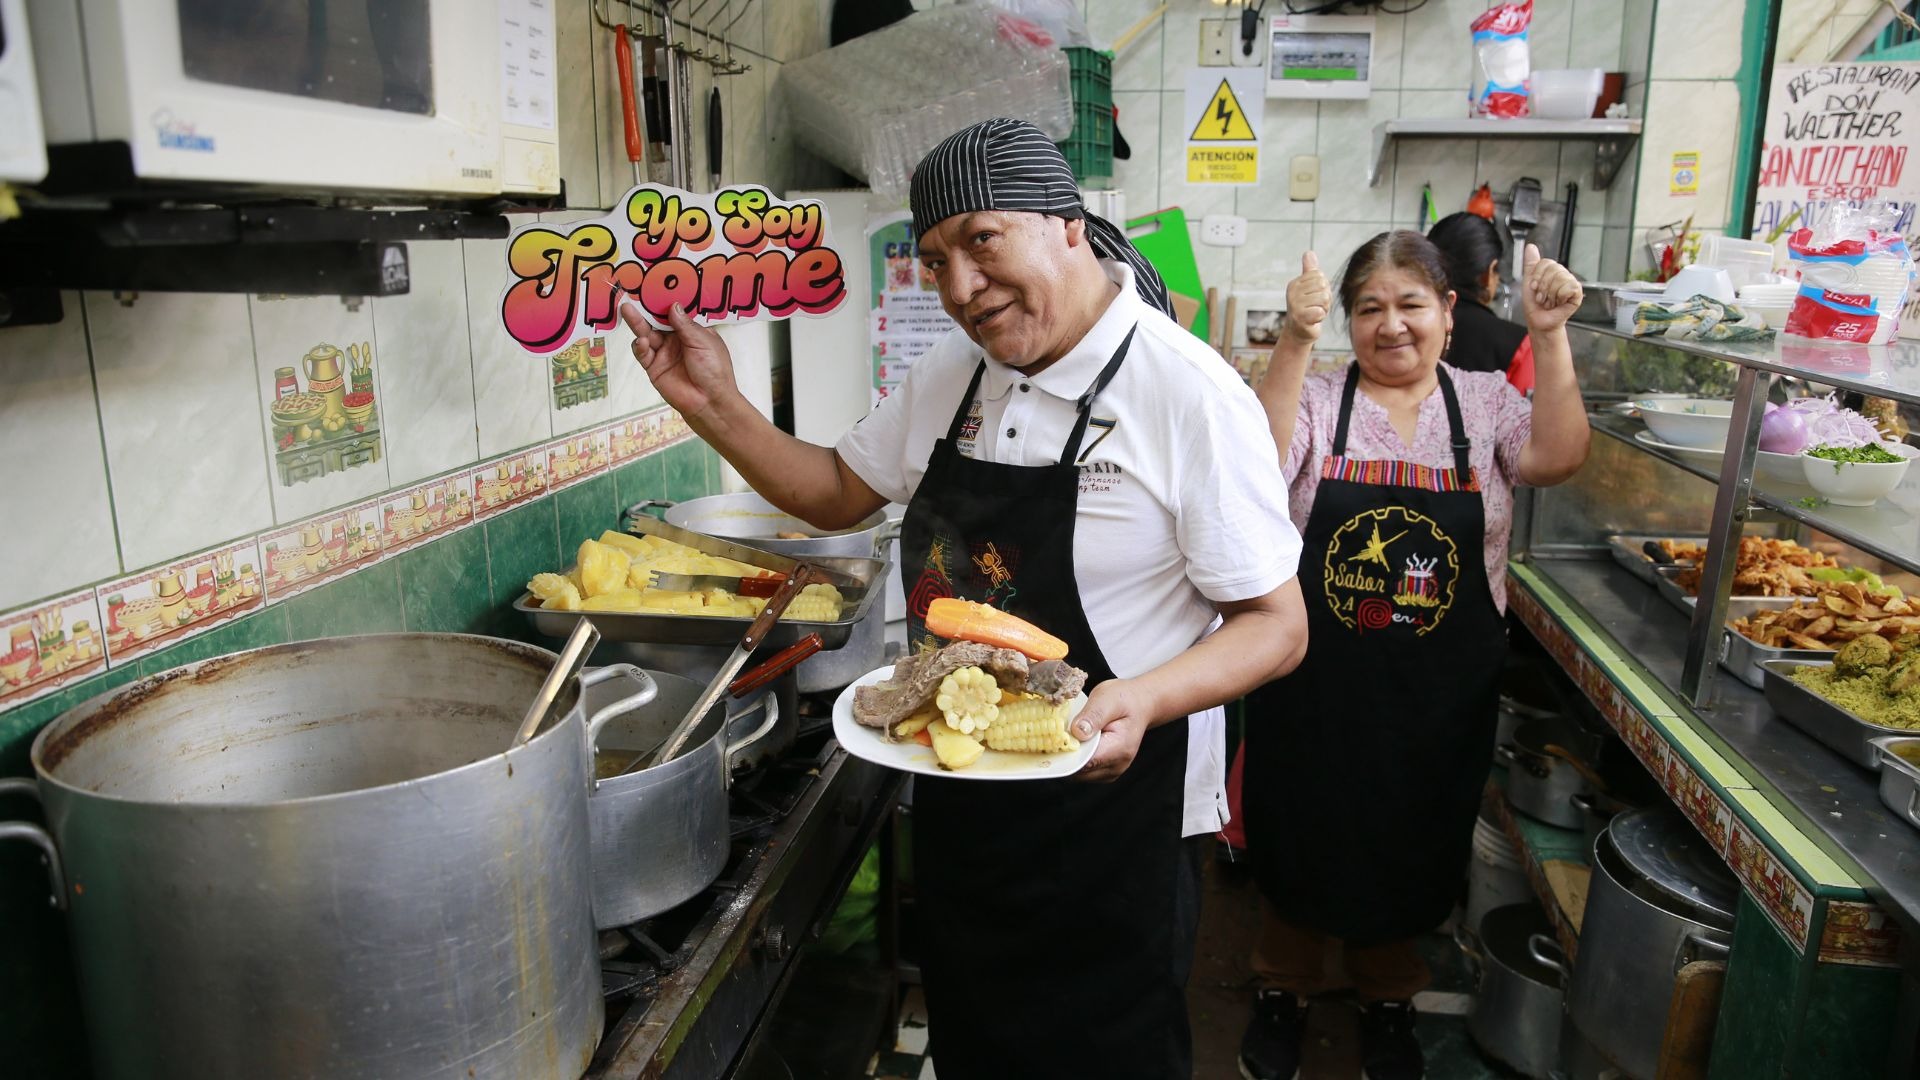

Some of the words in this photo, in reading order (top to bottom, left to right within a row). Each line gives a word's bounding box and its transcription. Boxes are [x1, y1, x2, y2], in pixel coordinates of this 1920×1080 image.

[1786, 66, 1920, 104] RESTAURANT
[1784, 110, 1902, 141] WALTHER
[1191, 150, 1255, 161] ATENCIÓN
[627, 188, 715, 264] Yo
[715, 188, 825, 255] Soy
[501, 223, 848, 355] Trome
[878, 316, 887, 331] 2
[1833, 322, 1862, 334] 25
[878, 341, 887, 356] 3
[877, 364, 887, 380] 4
[1077, 416, 1117, 464] 7
[1335, 563, 1385, 593] Sabor
[1342, 596, 1354, 611] A
